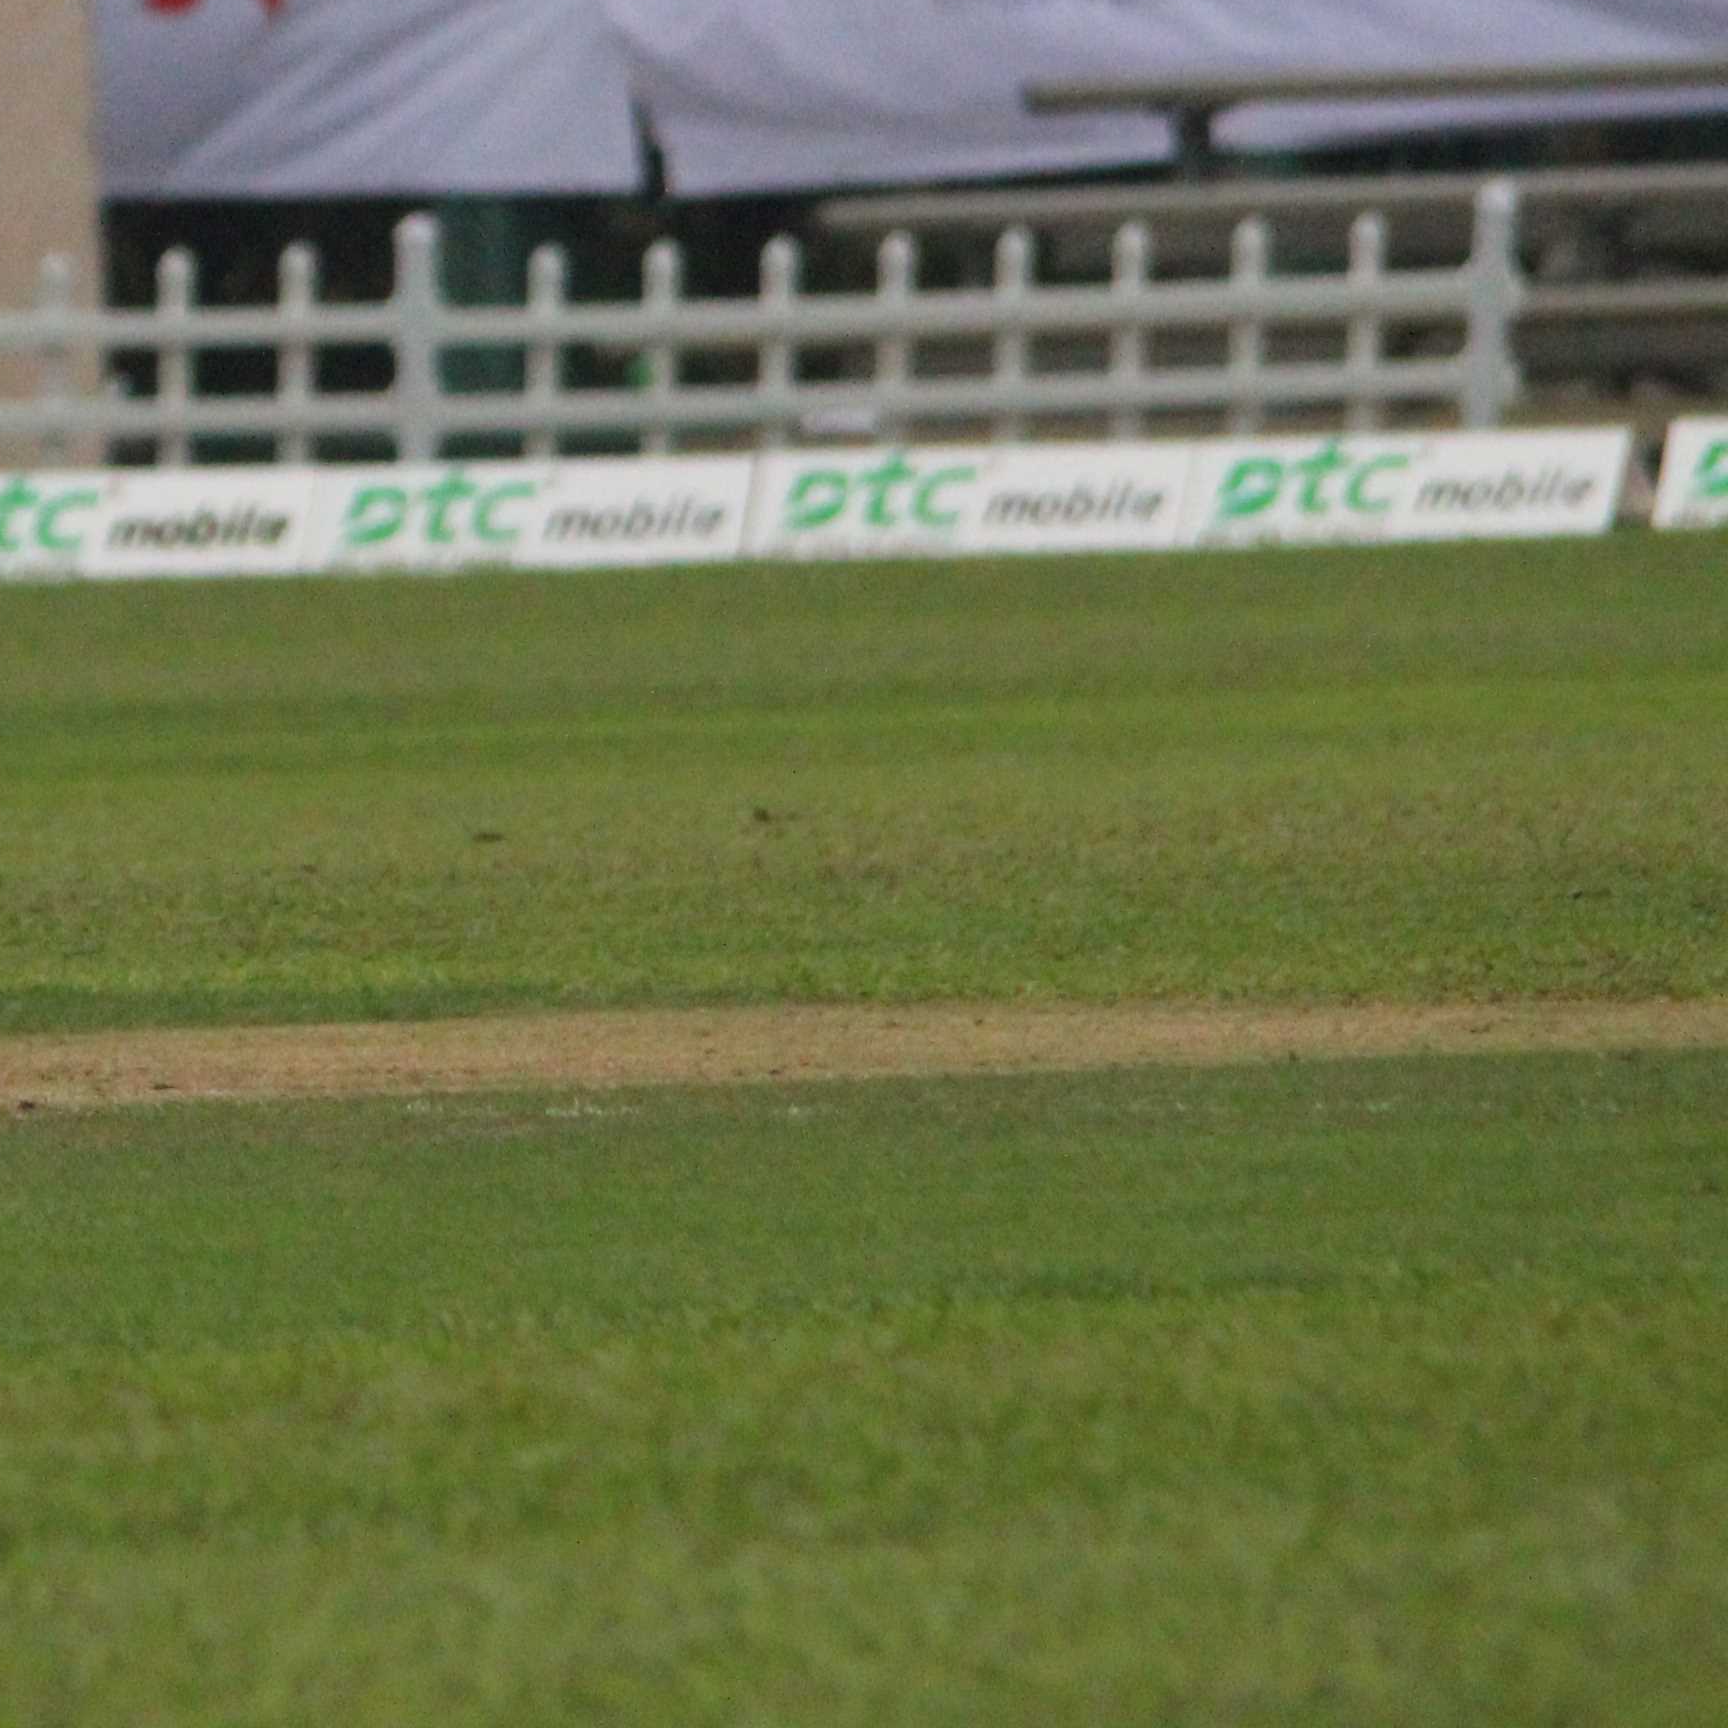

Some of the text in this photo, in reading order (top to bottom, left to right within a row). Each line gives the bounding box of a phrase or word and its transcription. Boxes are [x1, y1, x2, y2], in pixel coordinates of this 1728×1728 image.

[980, 474, 1164, 526] mobile
[1414, 464, 1594, 512] mobile
[106, 502, 290, 552] mobile
[543, 490, 726, 542] mobile
